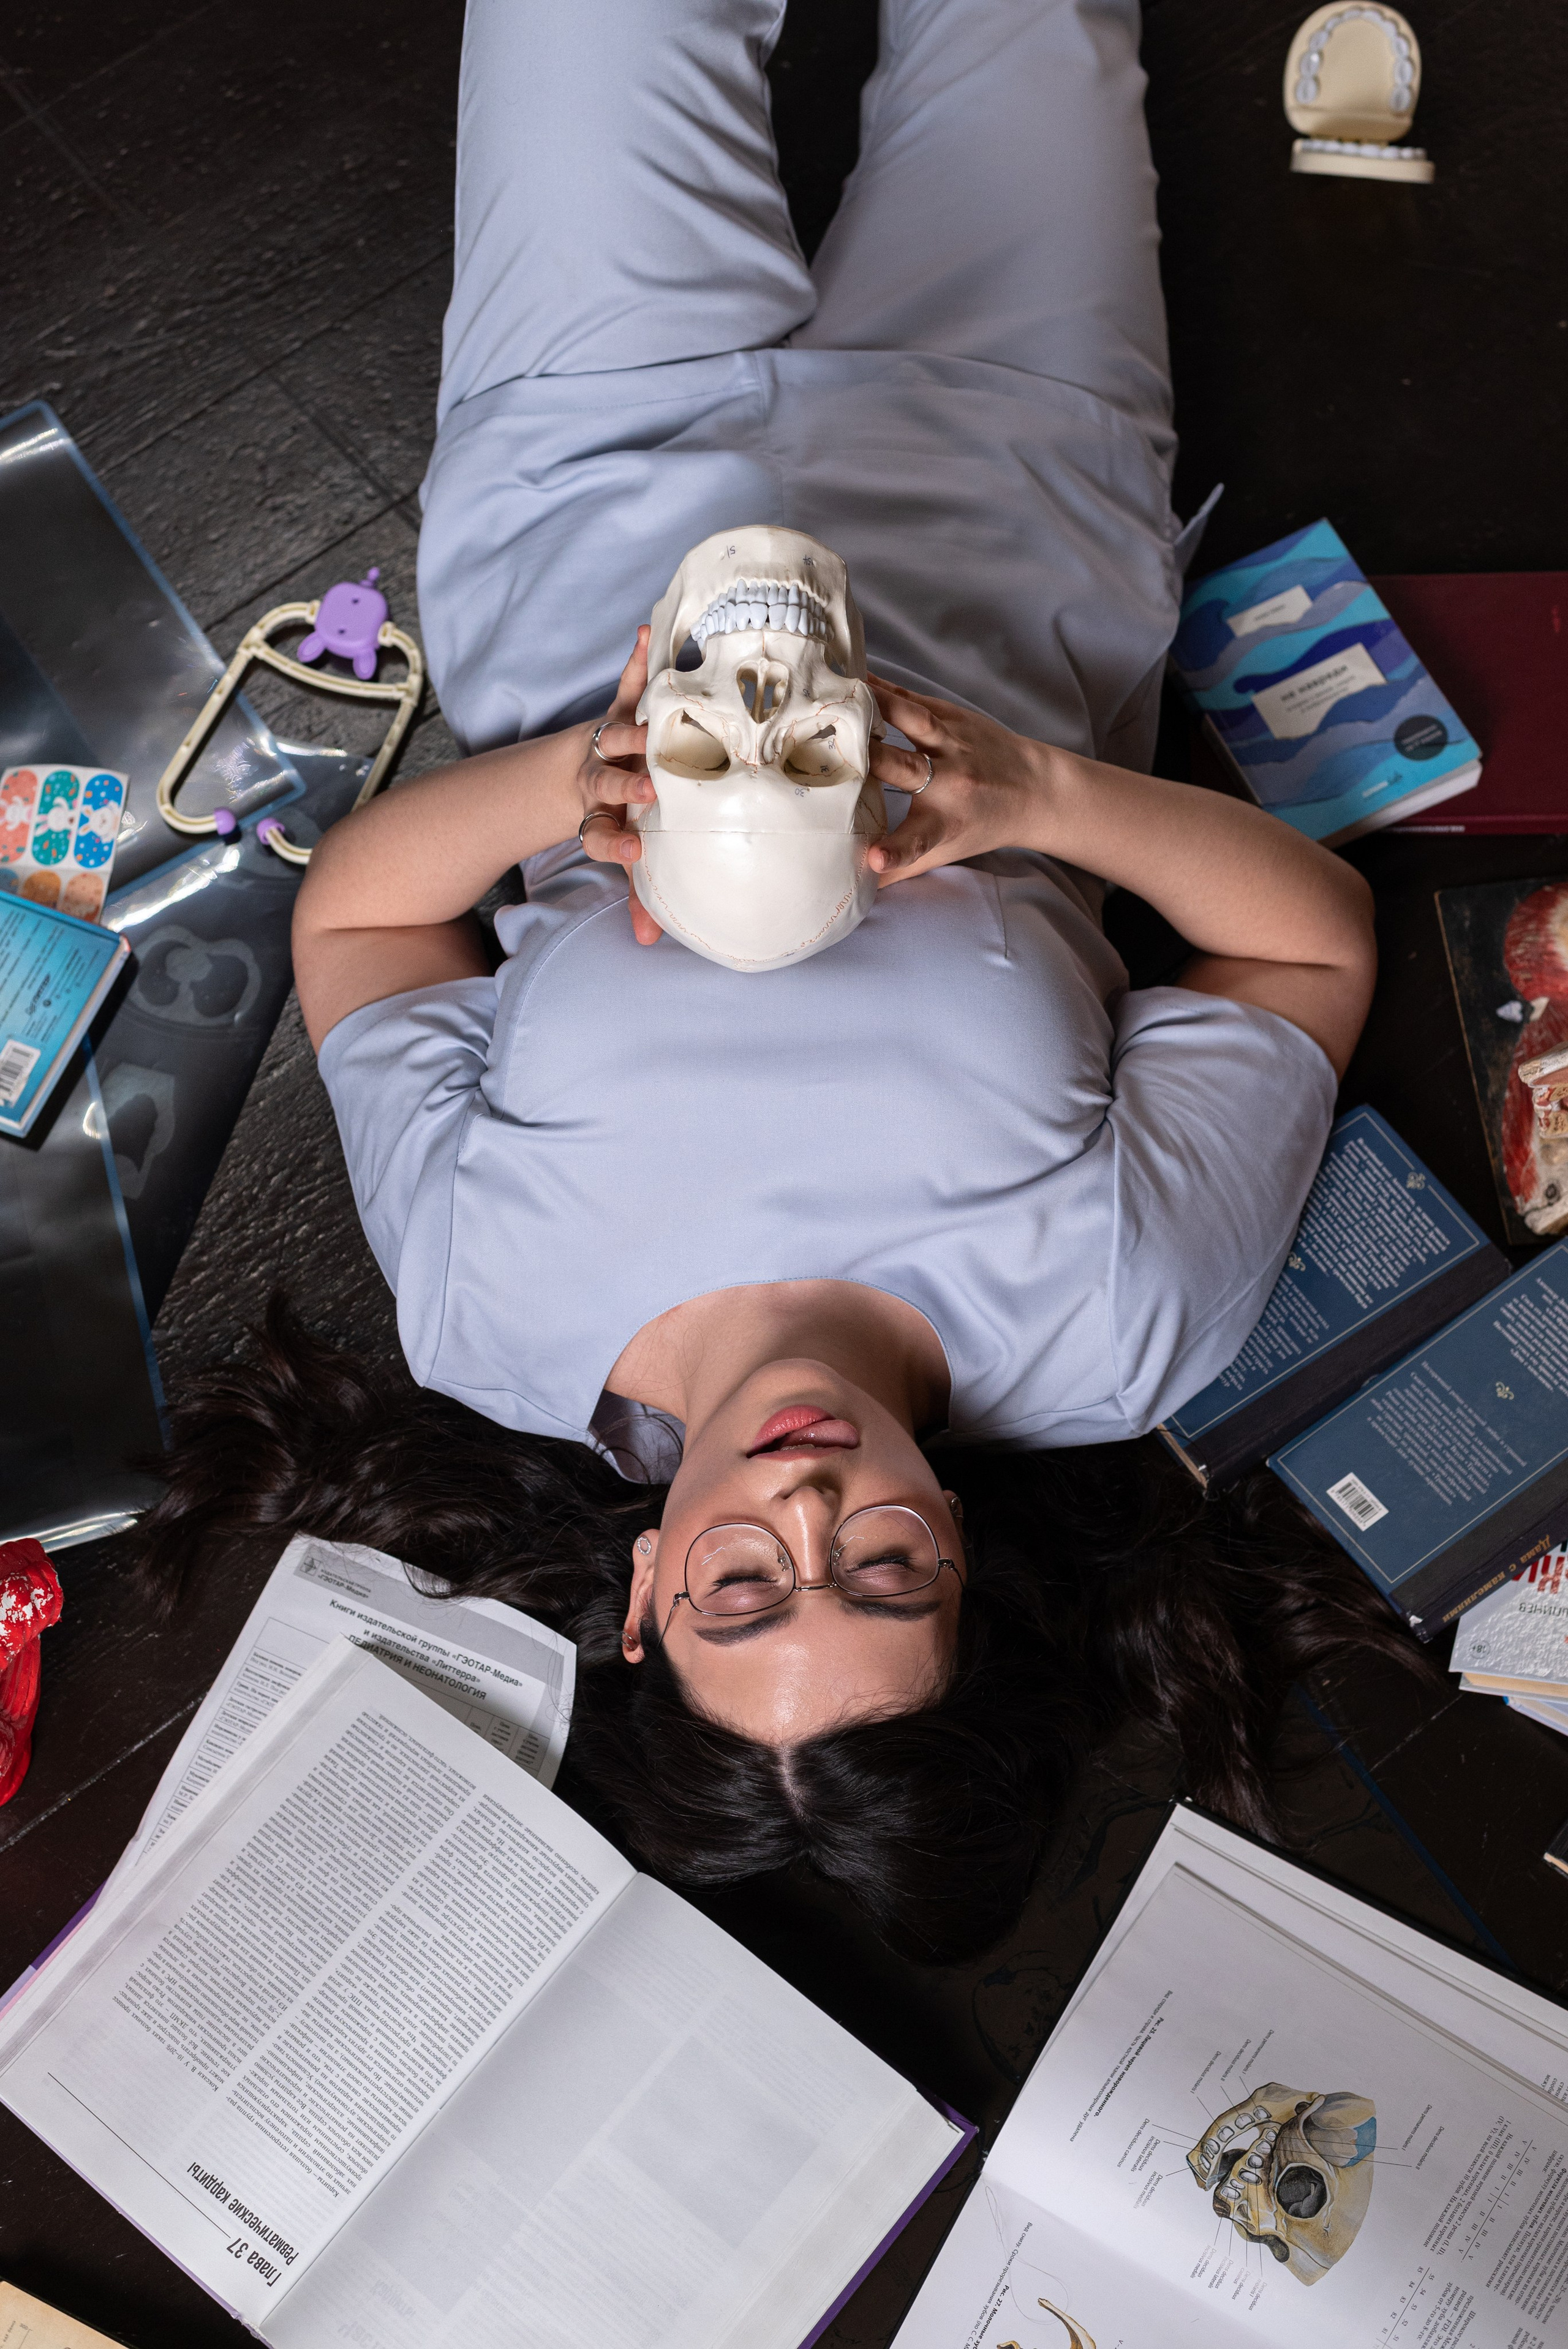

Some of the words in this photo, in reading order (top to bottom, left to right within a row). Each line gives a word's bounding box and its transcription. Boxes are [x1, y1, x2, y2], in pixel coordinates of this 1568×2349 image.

[1519, 1534, 1551, 1564] Дама
[1509, 1563, 1517, 1572] с
[1442, 1570, 1506, 1623] камелиями
[329, 1599, 356, 1616] Книги
[356, 1613, 418, 1643] издательской
[418, 1639, 450, 1657] группы
[452, 1653, 523, 1687] «ГЭОТАР-Медиа»
[370, 1632, 430, 1664] издательства
[431, 1659, 481, 1683] «Литтерра»
[347, 1634, 403, 1664] ПЕДИАТРИЯ
[412, 1664, 486, 1700] НЕОНАТОЛОГИЯ
[1164, 1990, 1174, 1999] Вид
[112, 1996, 131, 2013] процесс
[1152, 1998, 1167, 2016] спереди
[131, 2012, 151, 2032] больных
[1139, 2019, 1152, 2034] справа.
[1154, 2017, 1164, 2026] Рис.
[151, 2030, 166, 2045] таких
[1130, 2035, 1142, 2046] Часть
[1265, 2029, 1275, 2039] Dens
[165, 2043, 184, 2061] 10–20%
[1134, 2034, 1152, 2056] Лицевой
[1242, 2038, 1252, 2049] Dens
[1251, 2038, 1267, 2059] permanens
[1118, 2046, 1133, 2065] костной
[1124, 2056, 1136, 2072] череп
[1212, 2051, 1222, 2061] Dens
[1231, 2048, 1245, 2065] deciduus
[1109, 2065, 1121, 2078] ткани
[1200, 2060, 1215, 2078] deciduus
[1222, 2064, 1234, 2078] molaris
[1243, 2058, 1254, 2072] molaris
[197, 2071, 219, 2092] Коксаки
[1191, 2076, 1204, 2092] molaris
[226, 2096, 238, 2106] раз-
[1087, 2078, 1111, 2113] альвеолярных
[1093, 2071, 1126, 2117] новорожденного.
[232, 2089, 265, 2119] воспалитель-
[236, 2081, 288, 2128] характеризующихся
[1423, 2104, 1433, 2114] Dens
[236, 2105, 255, 2122] группа
[264, 2117, 293, 2144] патогенезу
[1069, 2121, 1084, 2142] удалена
[1139, 2118, 1150, 2130] Dens
[1411, 2113, 1426, 2135] permanens
[1435, 2125, 1445, 2136] Dens
[254, 2121, 289, 2153] гетерогенная
[292, 2128, 311, 2147] сердца,
[1127, 2129, 1142, 2151] deciduus
[1150, 2138, 1161, 2151] Dens
[1402, 2134, 1414, 2149] molaris
[1425, 2135, 1438, 2153] deciduus
[1117, 2149, 1129, 2168] caninus
[1494, 2140, 1508, 2159] каждой
[288, 2151, 312, 2174] большая
[298, 2147, 326, 2173] этиологии
[312, 2148, 345, 2178] заболеваний
[1131, 2154, 1145, 2173] lateralis
[1138, 2150, 1153, 2171] deciduus
[1417, 2152, 1428, 2167] molaris
[1481, 2158, 1497, 2181] половине
[186, 2162, 232, 2204] кардиты
[317, 2176, 339, 2198] Кардиты
[332, 2177, 352, 2195] личных
[347, 2178, 357, 2188] ных
[1153, 2174, 1163, 2187] Dens
[1133, 2190, 1146, 2209] medialis
[1141, 2186, 1156, 2207] deciduus
[1469, 2181, 1484, 2201] верхней
[1457, 2201, 1472, 2222] челюсти
[228, 2198, 300, 2266] Ревматические
[1023, 2222, 1033, 2233] Вид
[1446, 2224, 1458, 2240] резца
[226, 2238, 249, 2259] 37
[1016, 2233, 1026, 2248] снизу.
[1474, 2241, 1481, 2250] IV
[1006, 2249, 1019, 2266] Сроки
[1207, 2247, 1218, 2261] Dens
[1436, 2247, 1446, 2255] II),
[246, 2250, 282, 2287] Глава
[1189, 2262, 1202, 2279] medialis
[1197, 2259, 1210, 2279] deciduus
[1224, 2259, 1234, 2272] Dens
[987, 2266, 1009, 2304] прорезывания
[1207, 2273, 1219, 2289] lateralis
[1214, 2271, 1228, 2290] deciduus
[1233, 2267, 1245, 2285] caninus
[1241, 2271, 1251, 2283] Dens
[1000, 2285, 1010, 2297] Рис.
[1231, 2282, 1244, 2301] deciduus
[1250, 2278, 1262, 2295] molaris
[1257, 2281, 1268, 2295] Dens
[1441, 2281, 1453, 2298] зубов
[1248, 2293, 1261, 2312] deciduus
[1430, 2304, 1441, 2318] 5-го
[979, 2304, 990, 2320] зубов
[978, 2307, 998, 2339] Молочные
[1401, 2318, 1409, 2327] 52
[1425, 2317, 1432, 2326] до
[1416, 2326, 1429, 2341] 8-го:
